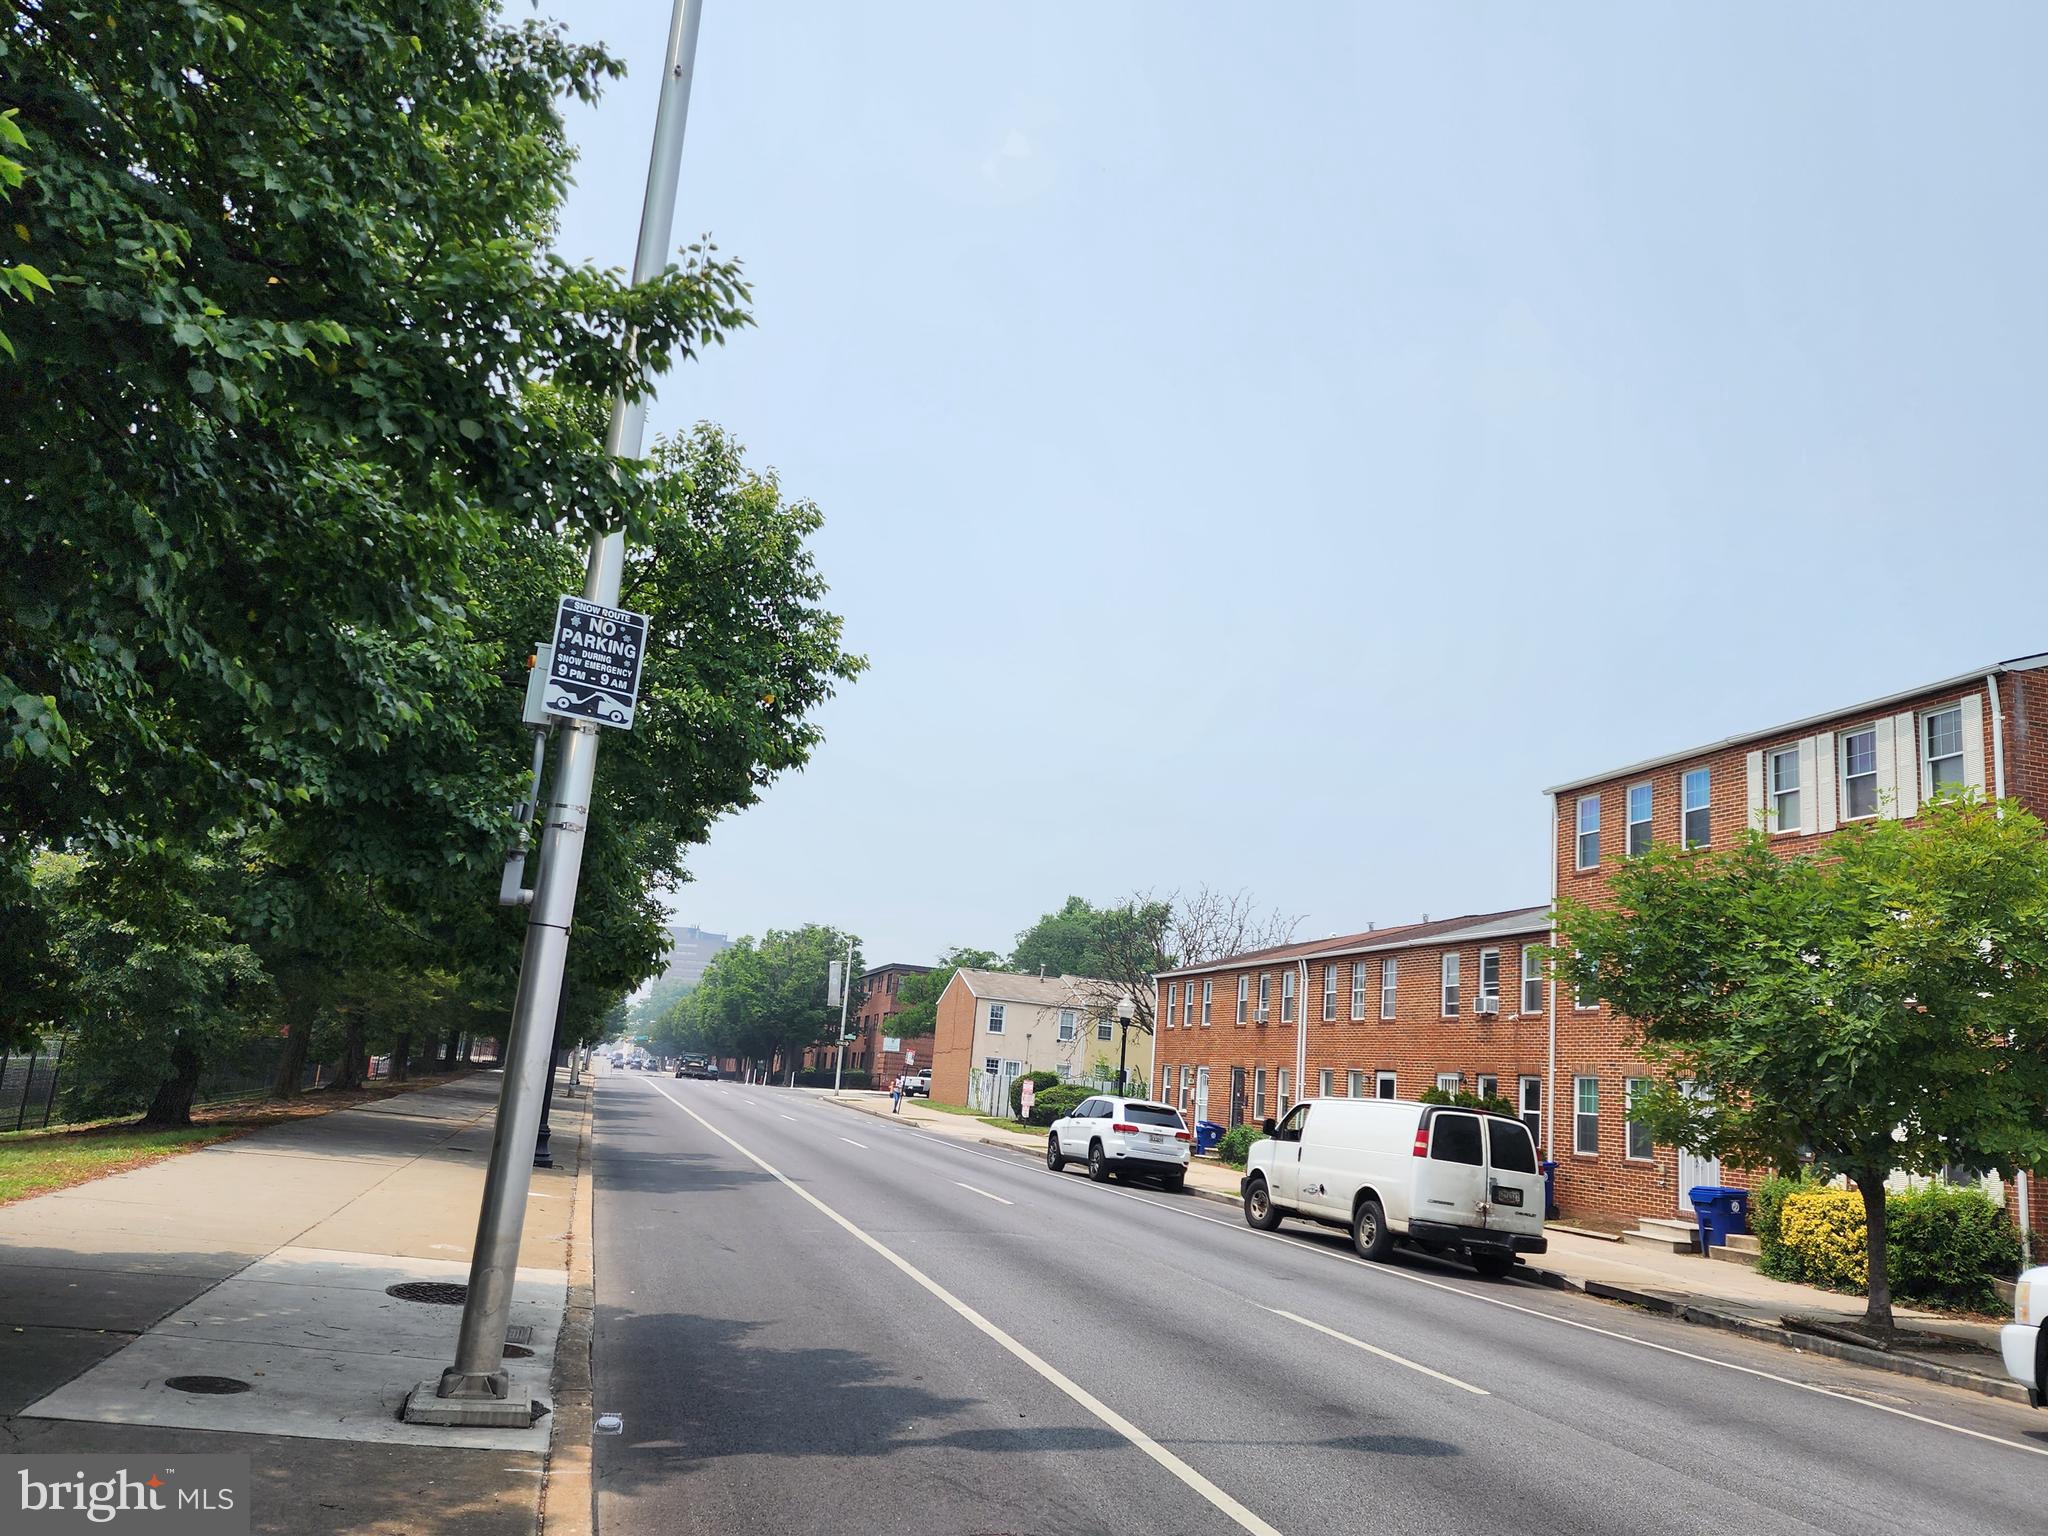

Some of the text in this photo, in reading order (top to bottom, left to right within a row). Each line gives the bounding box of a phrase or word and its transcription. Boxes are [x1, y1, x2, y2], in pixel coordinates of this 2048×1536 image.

[574, 602, 630, 622] SNOW ROUTE
[589, 618, 616, 636] NO
[561, 628, 636, 658] PARKING
[557, 653, 632, 677] SNOW EMERGENCY
[582, 650, 611, 663] DURING
[558, 664, 568, 676] 9
[569, 669, 586, 680] PM
[600, 674, 609, 685] 9
[610, 678, 627, 689] AM
